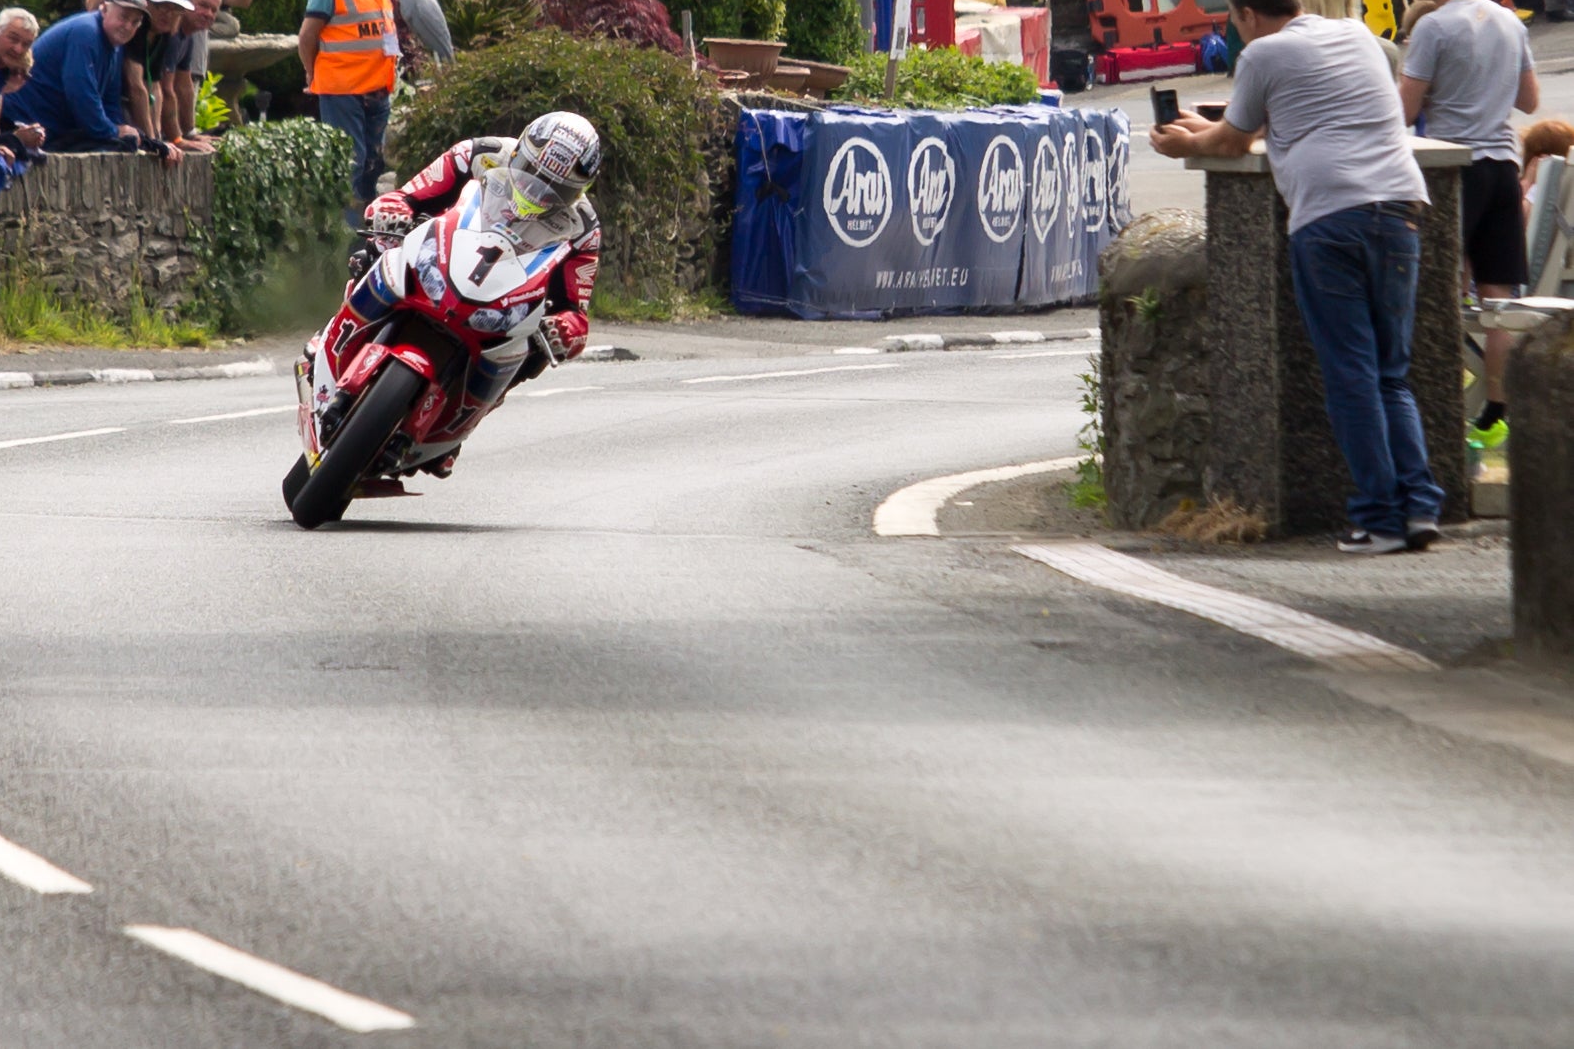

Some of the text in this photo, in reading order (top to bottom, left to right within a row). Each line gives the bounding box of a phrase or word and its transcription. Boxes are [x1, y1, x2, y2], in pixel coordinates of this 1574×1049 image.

[829, 149, 886, 215] Arai
[468, 245, 504, 288] 1
[331, 317, 358, 357] 1
